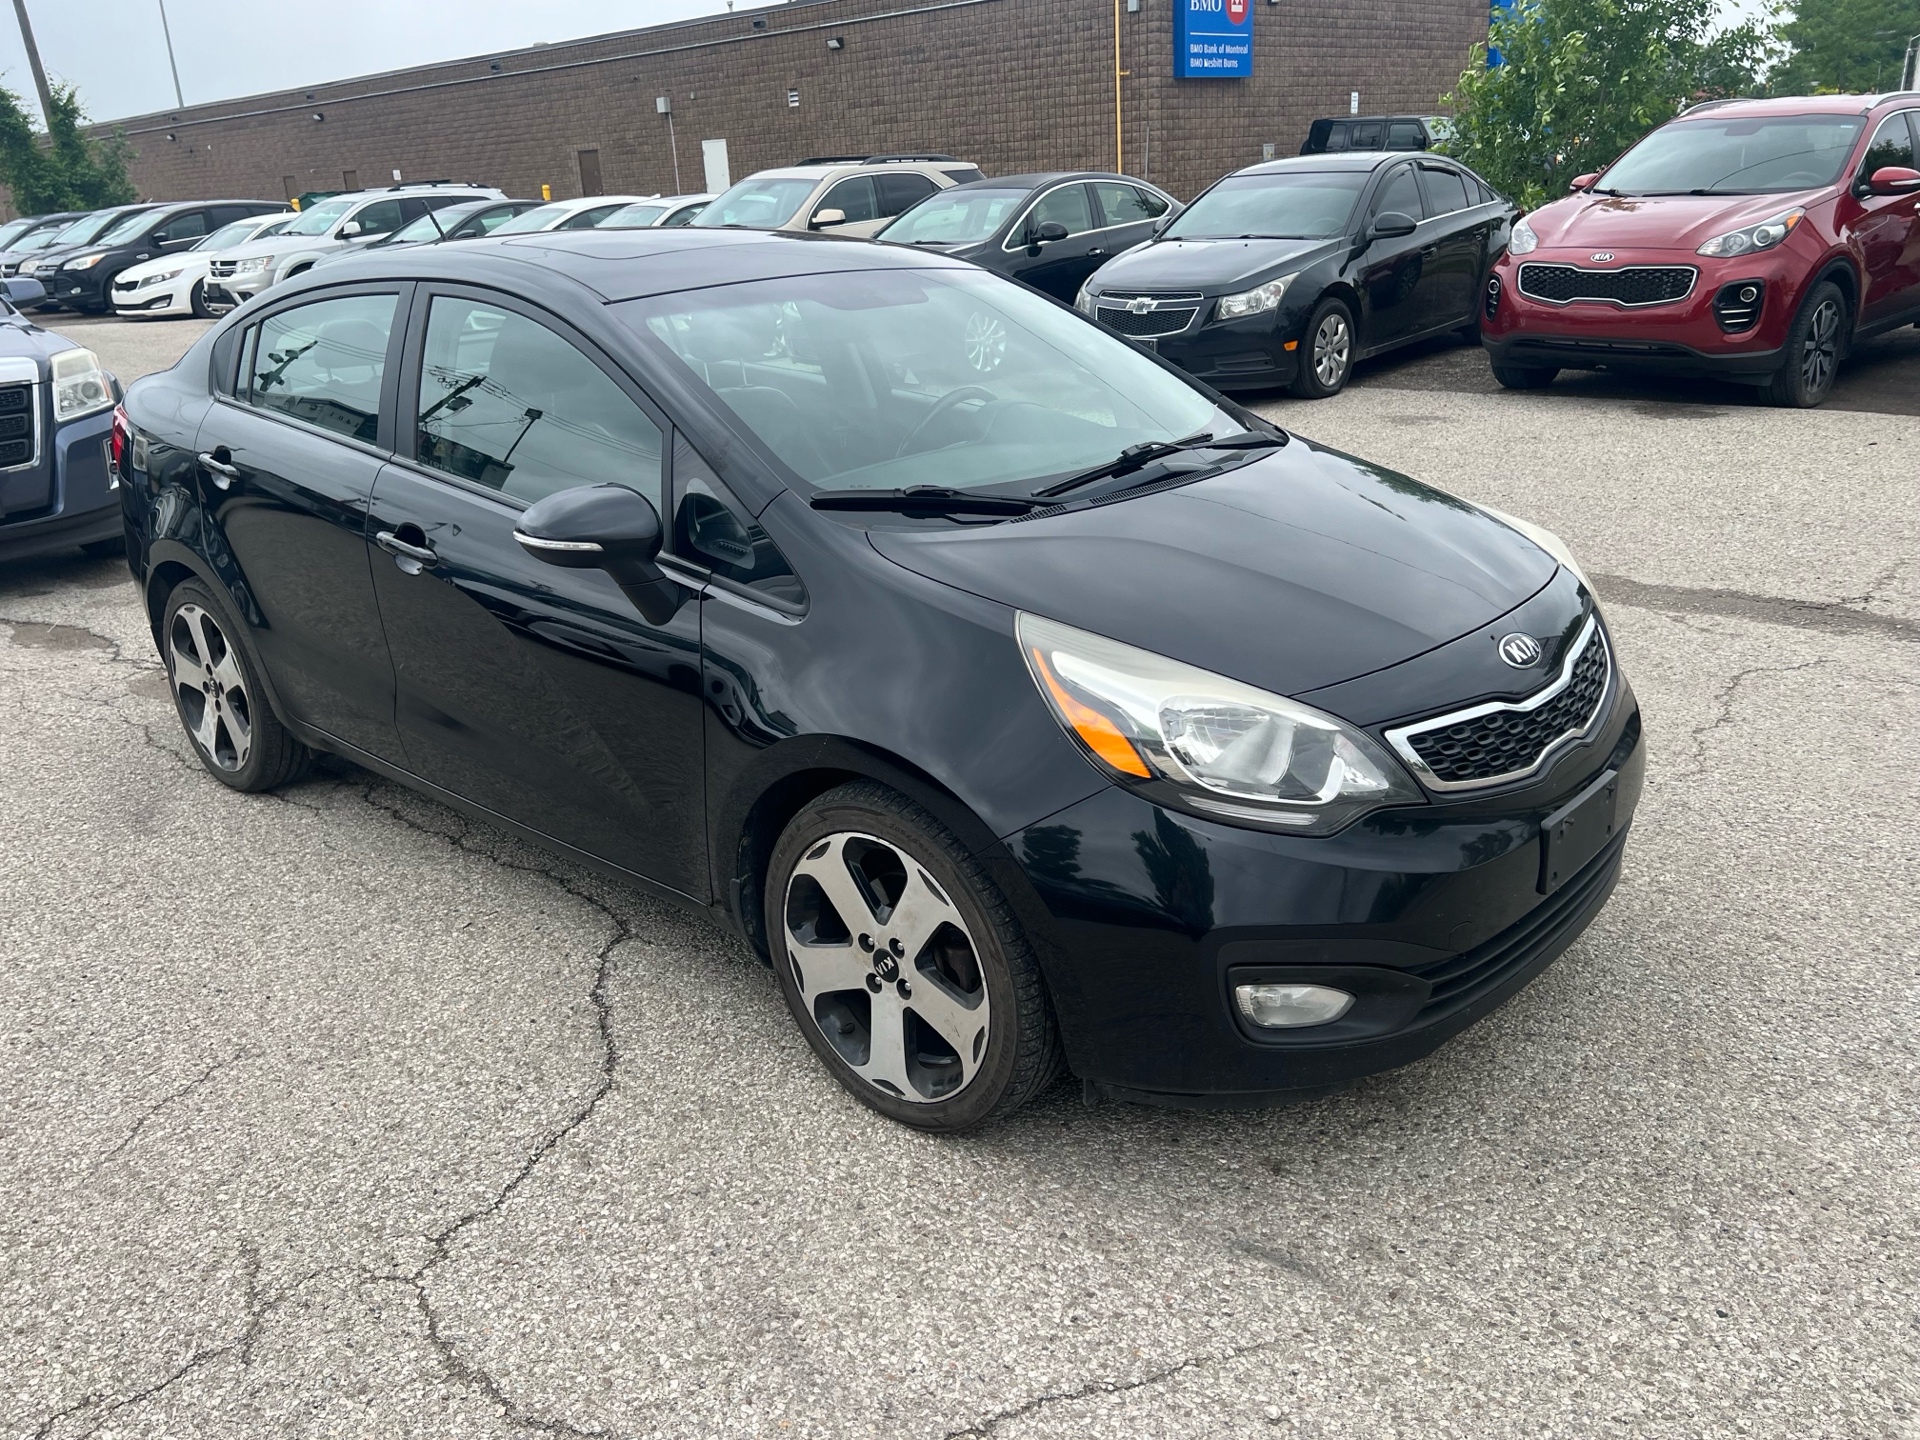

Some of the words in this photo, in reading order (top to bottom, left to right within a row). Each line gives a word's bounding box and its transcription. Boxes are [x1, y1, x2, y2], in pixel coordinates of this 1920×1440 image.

[1190, 0, 1222, 12] BMO
[1190, 43, 1203, 53] BMO
[1204, 43, 1217, 54] Bank
[1218, 43, 1225, 53] of
[1225, 43, 1249, 54] Montreal
[1190, 58, 1203, 68] BMO
[1204, 57, 1223, 68] Nesbitt
[1223, 58, 1238, 68] Burns
[1505, 636, 1540, 663] KIA
[875, 956, 895, 975] KIA
